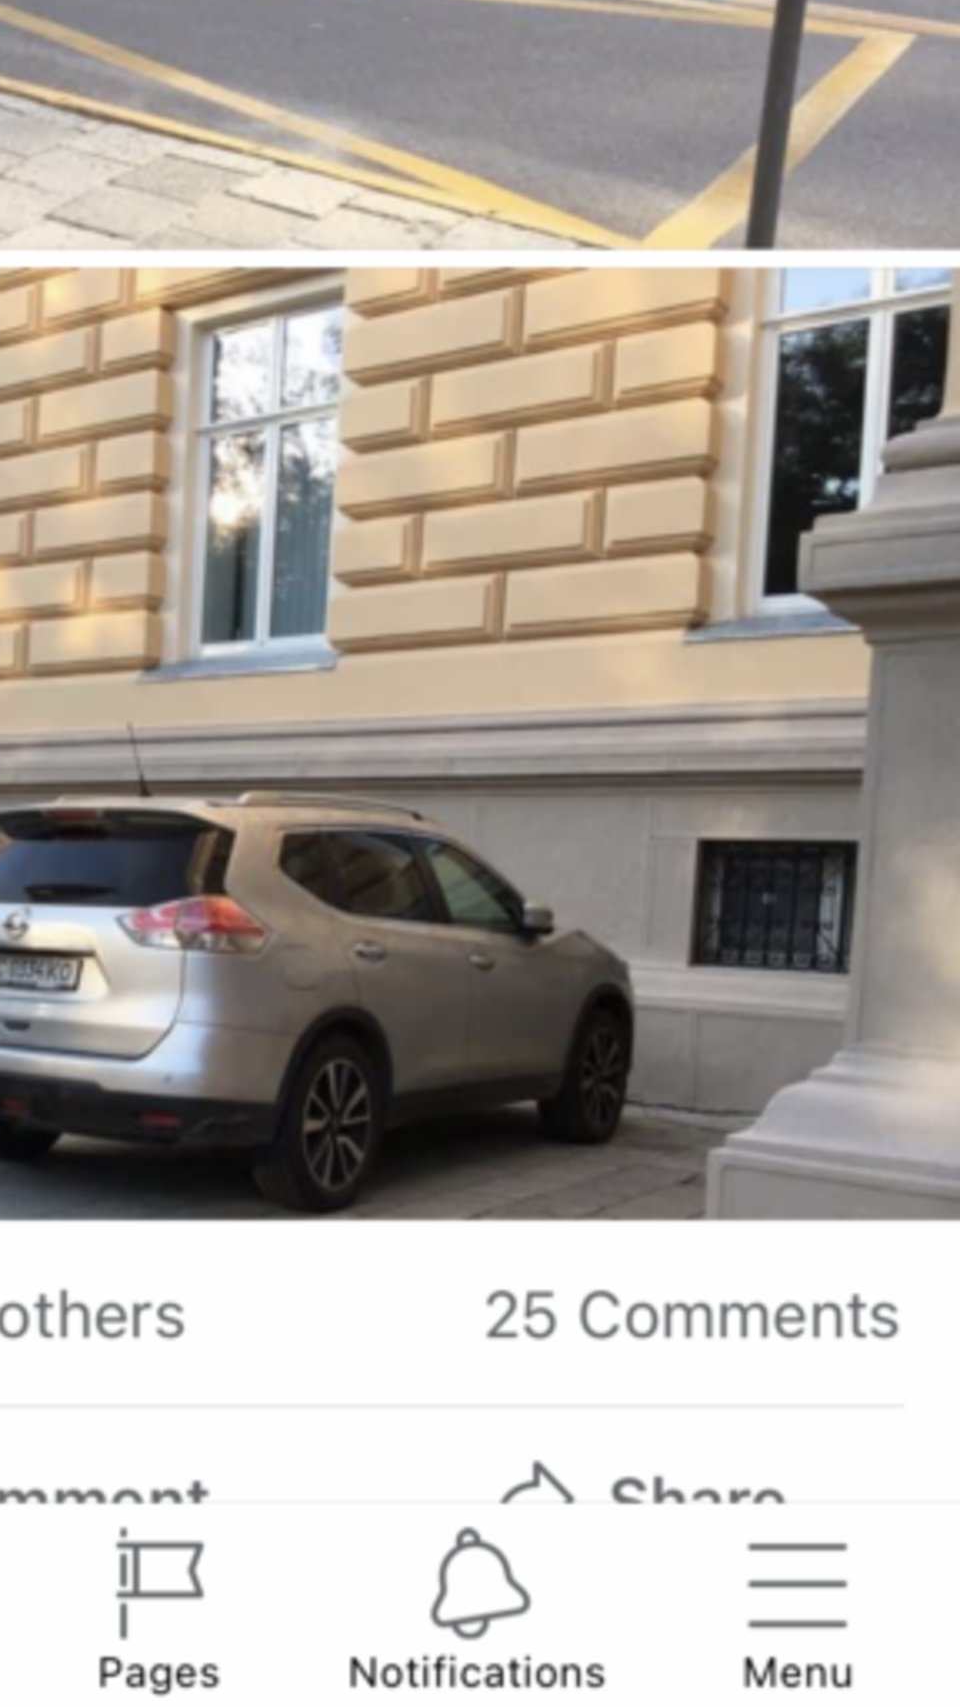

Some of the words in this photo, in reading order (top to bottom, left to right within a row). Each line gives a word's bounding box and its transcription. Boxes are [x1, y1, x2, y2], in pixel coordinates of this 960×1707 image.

[487, 1290, 556, 1339] 25
[580, 1290, 898, 1339] Comments
[99, 1656, 220, 1696] Pages
[350, 1655, 605, 1688] Notifications
[744, 1656, 852, 1688] Menu
